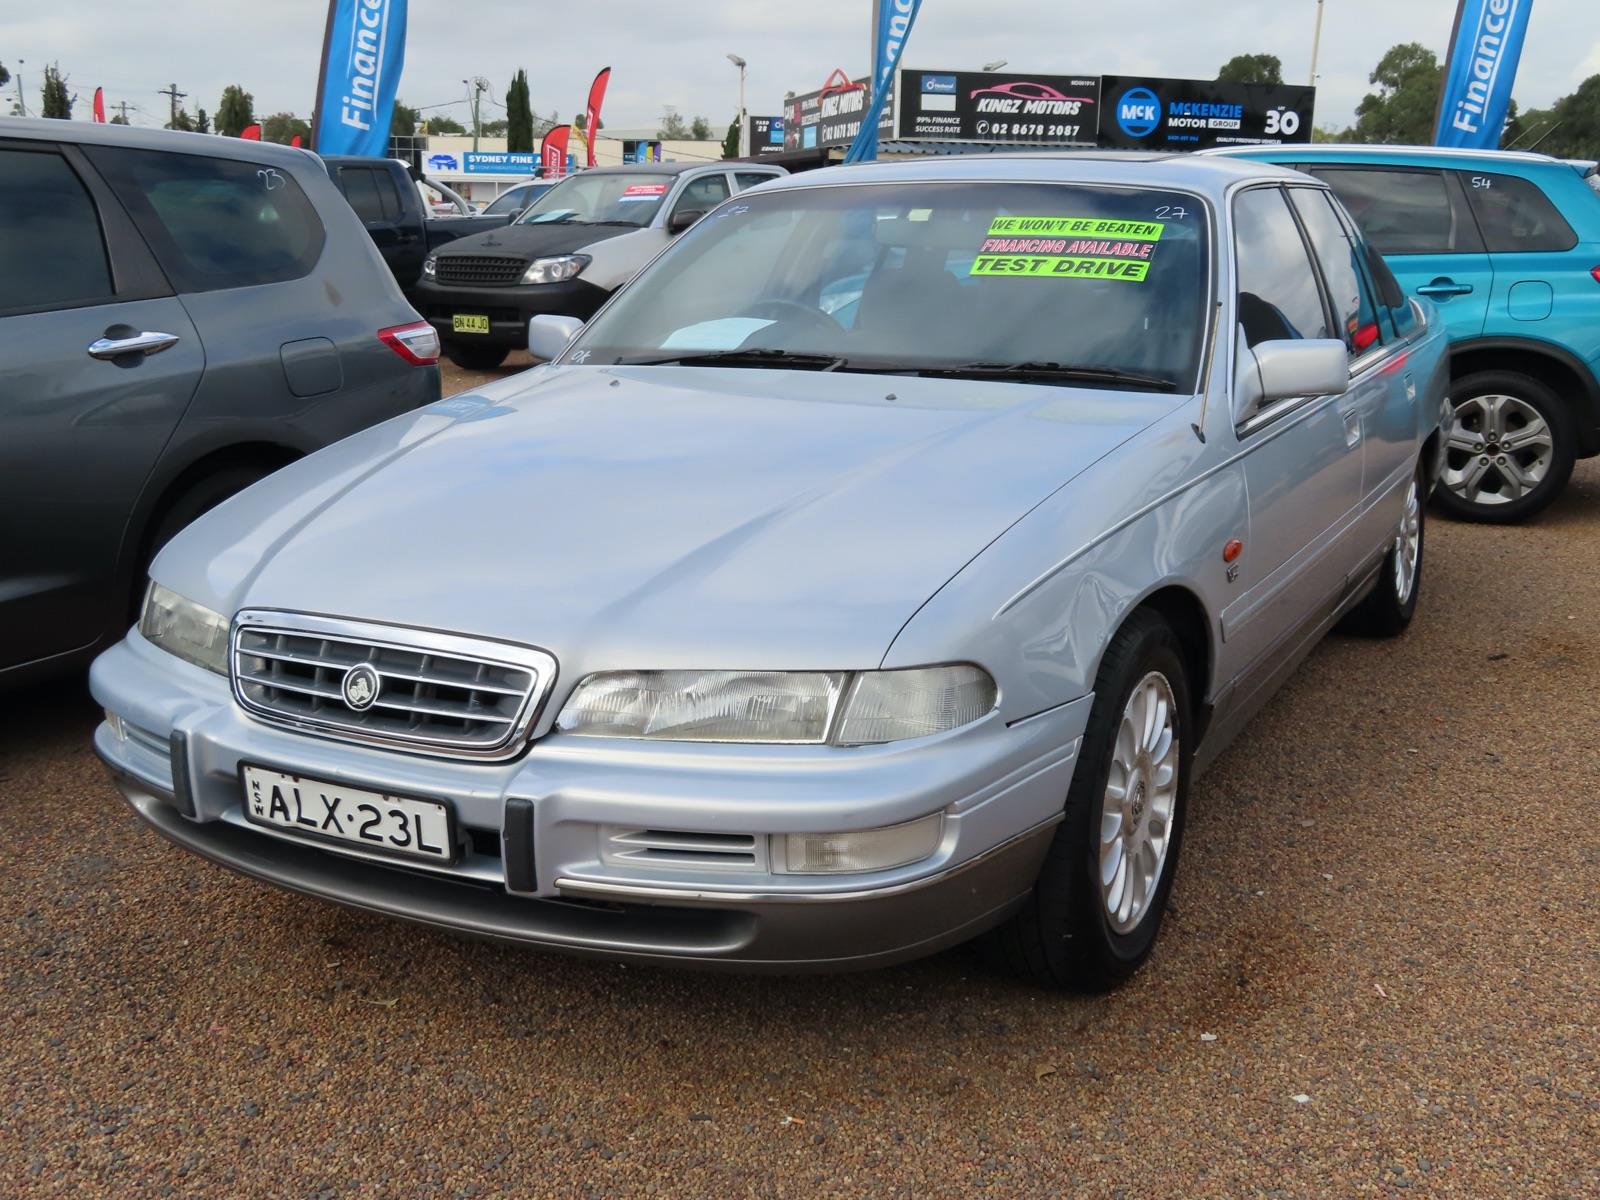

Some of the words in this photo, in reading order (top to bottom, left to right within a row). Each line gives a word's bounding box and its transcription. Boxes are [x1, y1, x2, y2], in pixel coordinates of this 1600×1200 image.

[1452, 0, 1509, 133] Finance
[976, 98, 1023, 114] KINGZ
[1023, 100, 1082, 115] MOTORS
[916, 116, 931, 124] 99%
[932, 116, 960, 124] FINANCE
[1168, 117, 1207, 129] MOTOR
[1212, 120, 1239, 129] GROUP
[1264, 109, 1300, 136] 30
[915, 125, 944, 133] SUCCESS
[992, 123, 1008, 135] 02
[1012, 124, 1045, 136] 8678
[1047, 125, 1081, 137] 2087
[468, 155, 508, 164] SYDNEY
[511, 156, 533, 164] FINE
[1471, 176, 1491, 189] 54
[1155, 206, 1188, 220] 27
[991, 219, 1014, 230] WE
[1021, 220, 1066, 232] WON'T
[1070, 221, 1093, 232] BE
[1095, 223, 1156, 235] BEATEN
[980, 239, 1064, 253] FINANCING
[1067, 241, 1153, 258] AVAILABLE
[976, 258, 1047, 273] TEST
[1053, 260, 1143, 277] DRIVE
